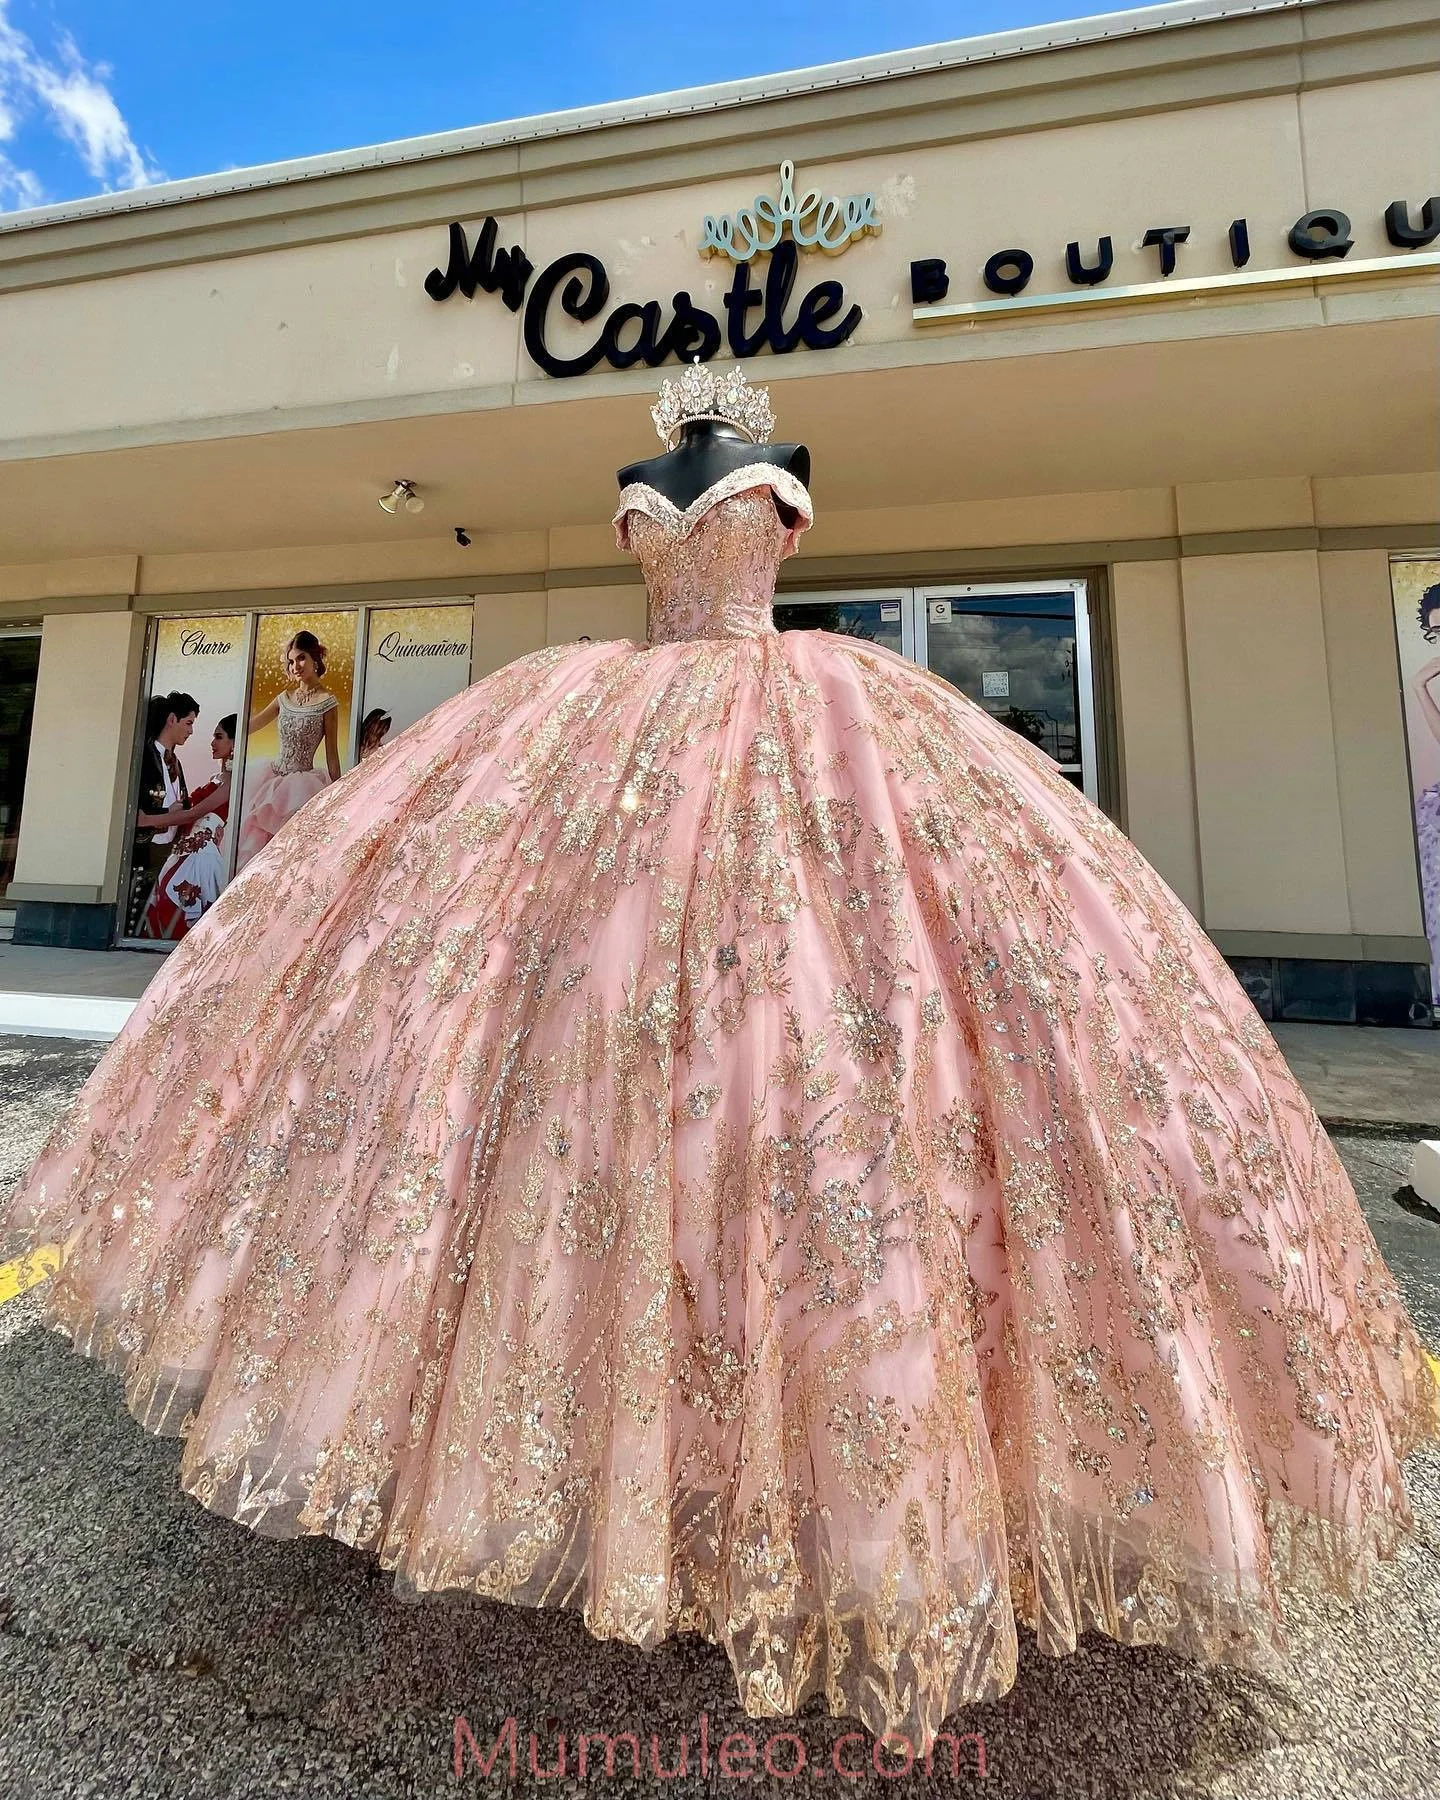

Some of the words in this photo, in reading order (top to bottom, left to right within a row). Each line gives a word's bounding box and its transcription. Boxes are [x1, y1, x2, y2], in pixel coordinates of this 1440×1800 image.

[425, 216, 534, 312] My
[523, 240, 862, 378] Castle
[910, 197, 1440, 304] BOUTIQU
[180, 629, 232, 656] Charro
[374, 631, 469, 663] Quinceañera
